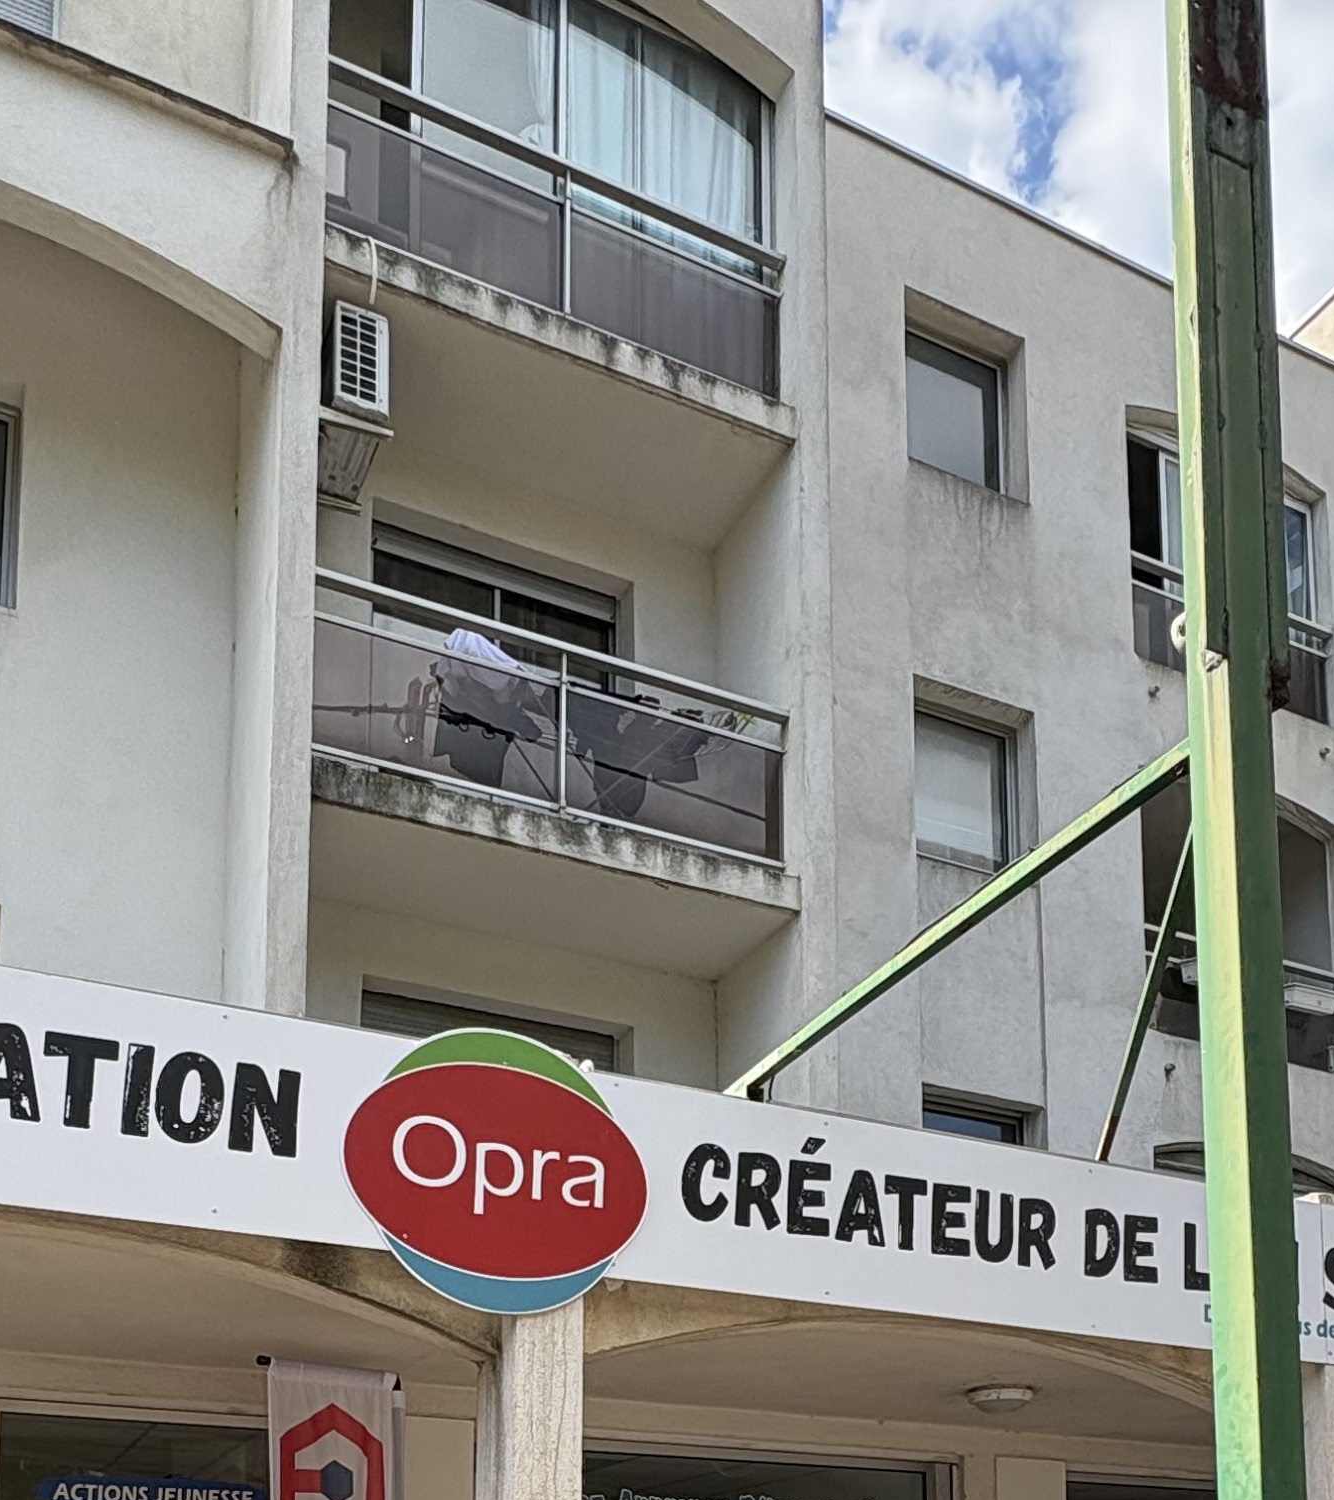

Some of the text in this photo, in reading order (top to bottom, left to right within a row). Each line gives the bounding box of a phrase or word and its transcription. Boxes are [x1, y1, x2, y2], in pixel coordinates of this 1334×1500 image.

[391, 1114, 606, 1215] Opra
[681, 1136, 1056, 1270] CRÉATEUR
[1084, 1208, 1158, 1283] DE
